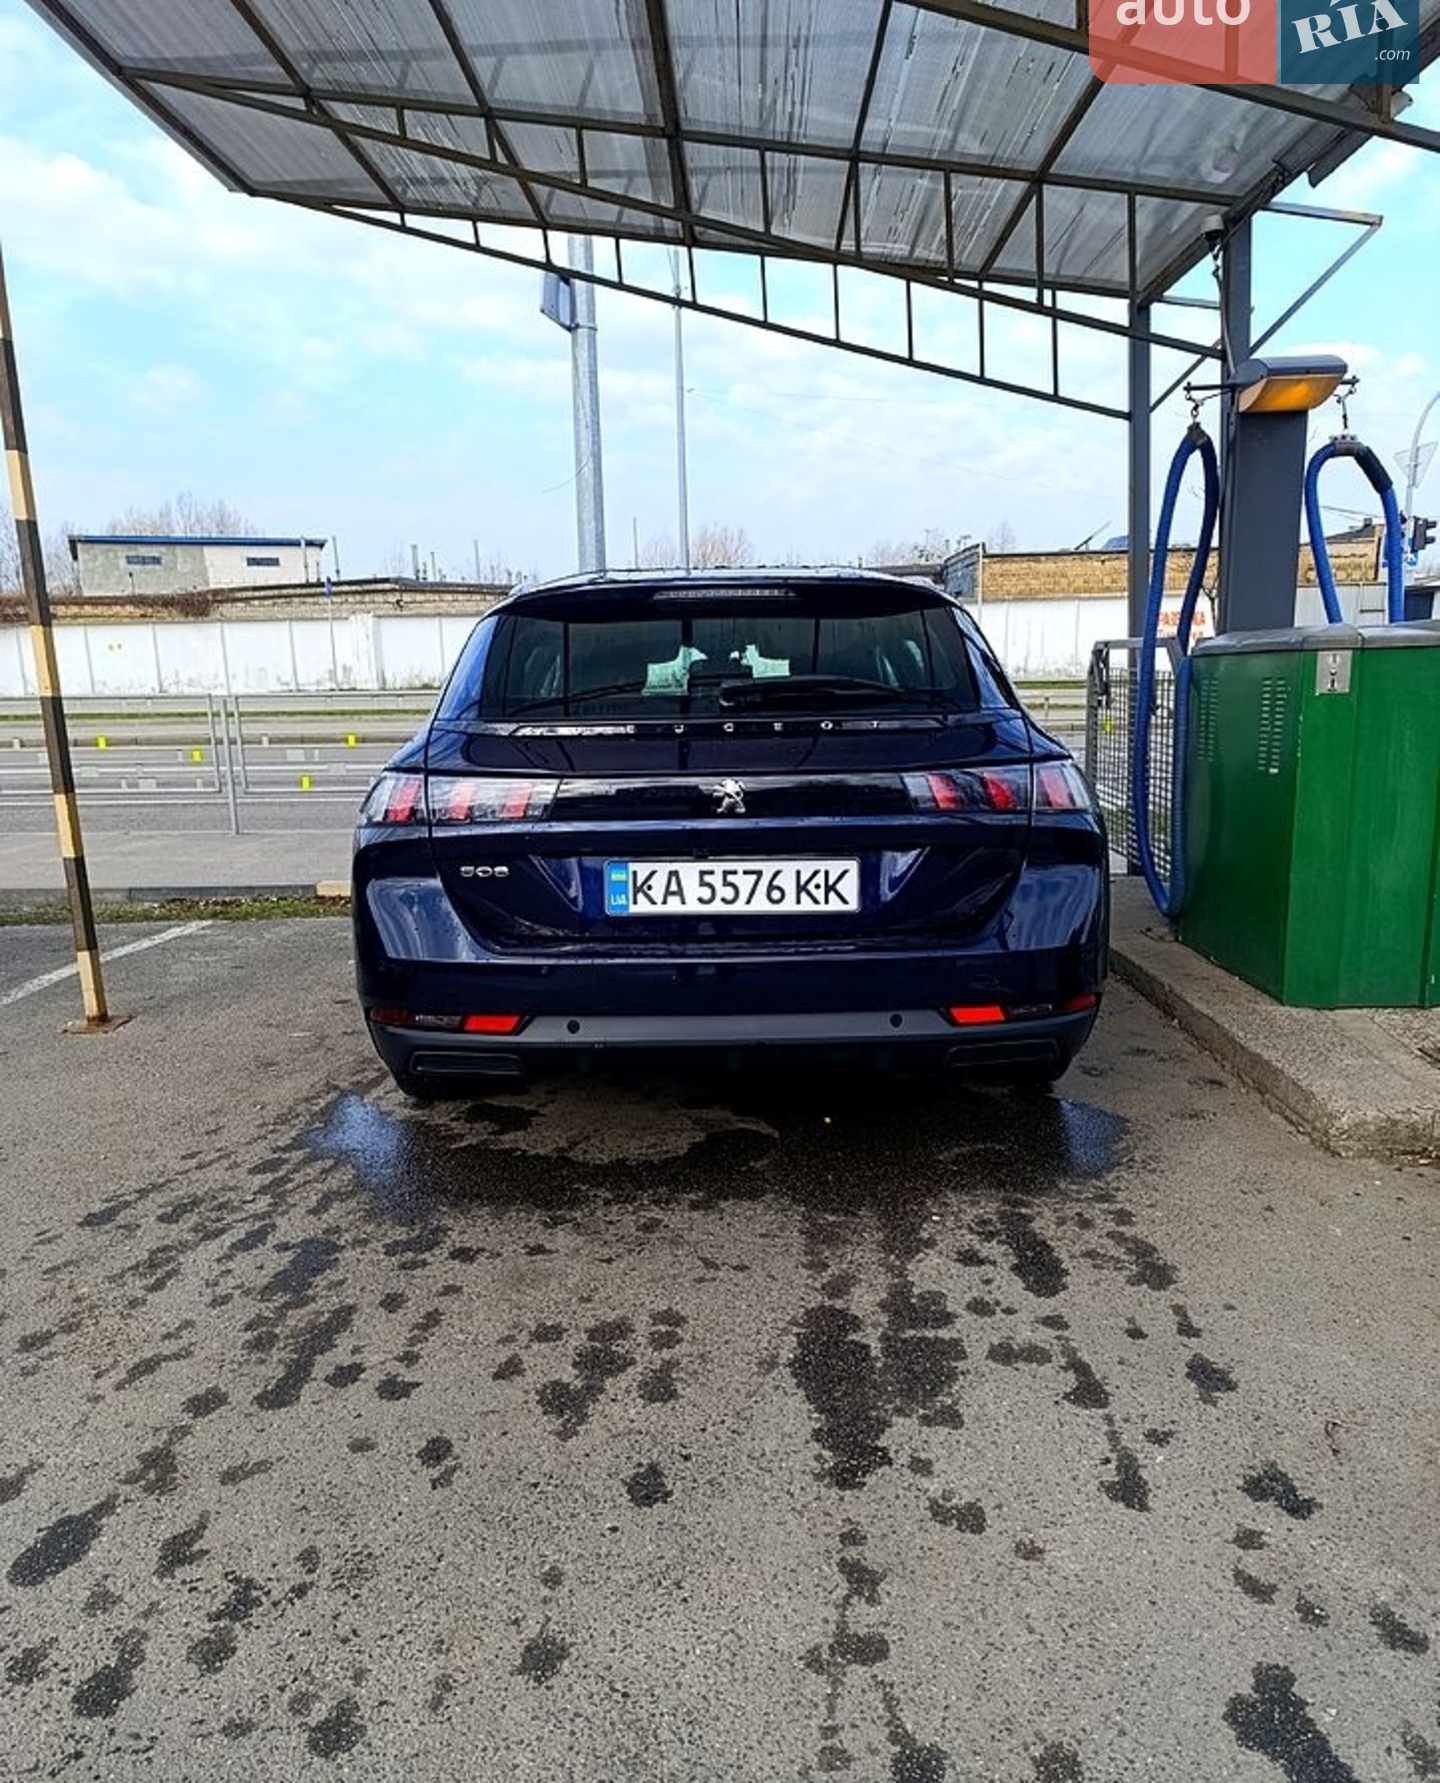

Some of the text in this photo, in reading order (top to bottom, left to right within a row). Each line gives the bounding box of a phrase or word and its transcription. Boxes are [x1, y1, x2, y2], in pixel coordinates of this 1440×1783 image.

[577, 720, 879, 735] EUGEOT
[631, 868, 851, 905] KA 5576 KK
[610, 894, 628, 906] UA
